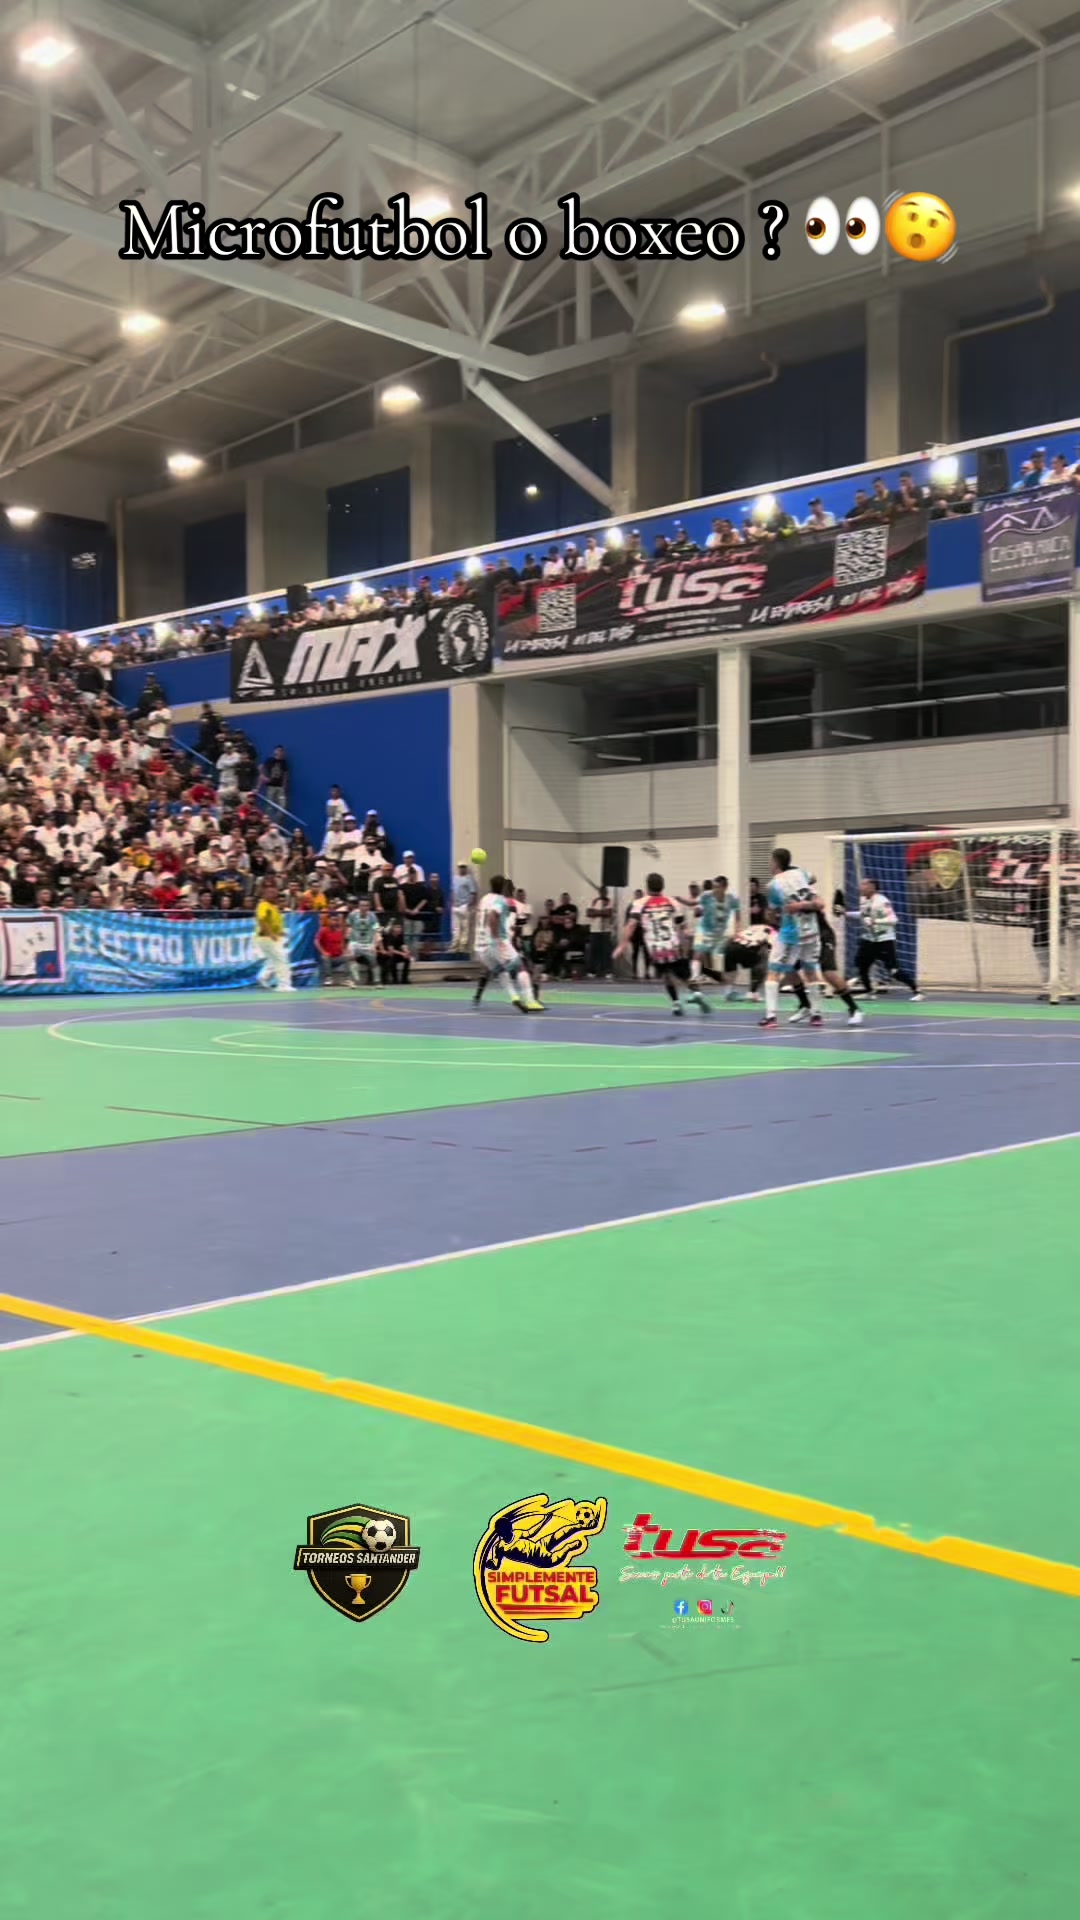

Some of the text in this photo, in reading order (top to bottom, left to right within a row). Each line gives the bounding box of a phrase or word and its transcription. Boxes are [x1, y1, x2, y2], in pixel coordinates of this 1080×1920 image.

[749, 606, 769, 623] LA
[283, 610, 438, 685] MAX
[68, 922, 184, 964] ELECTRO
